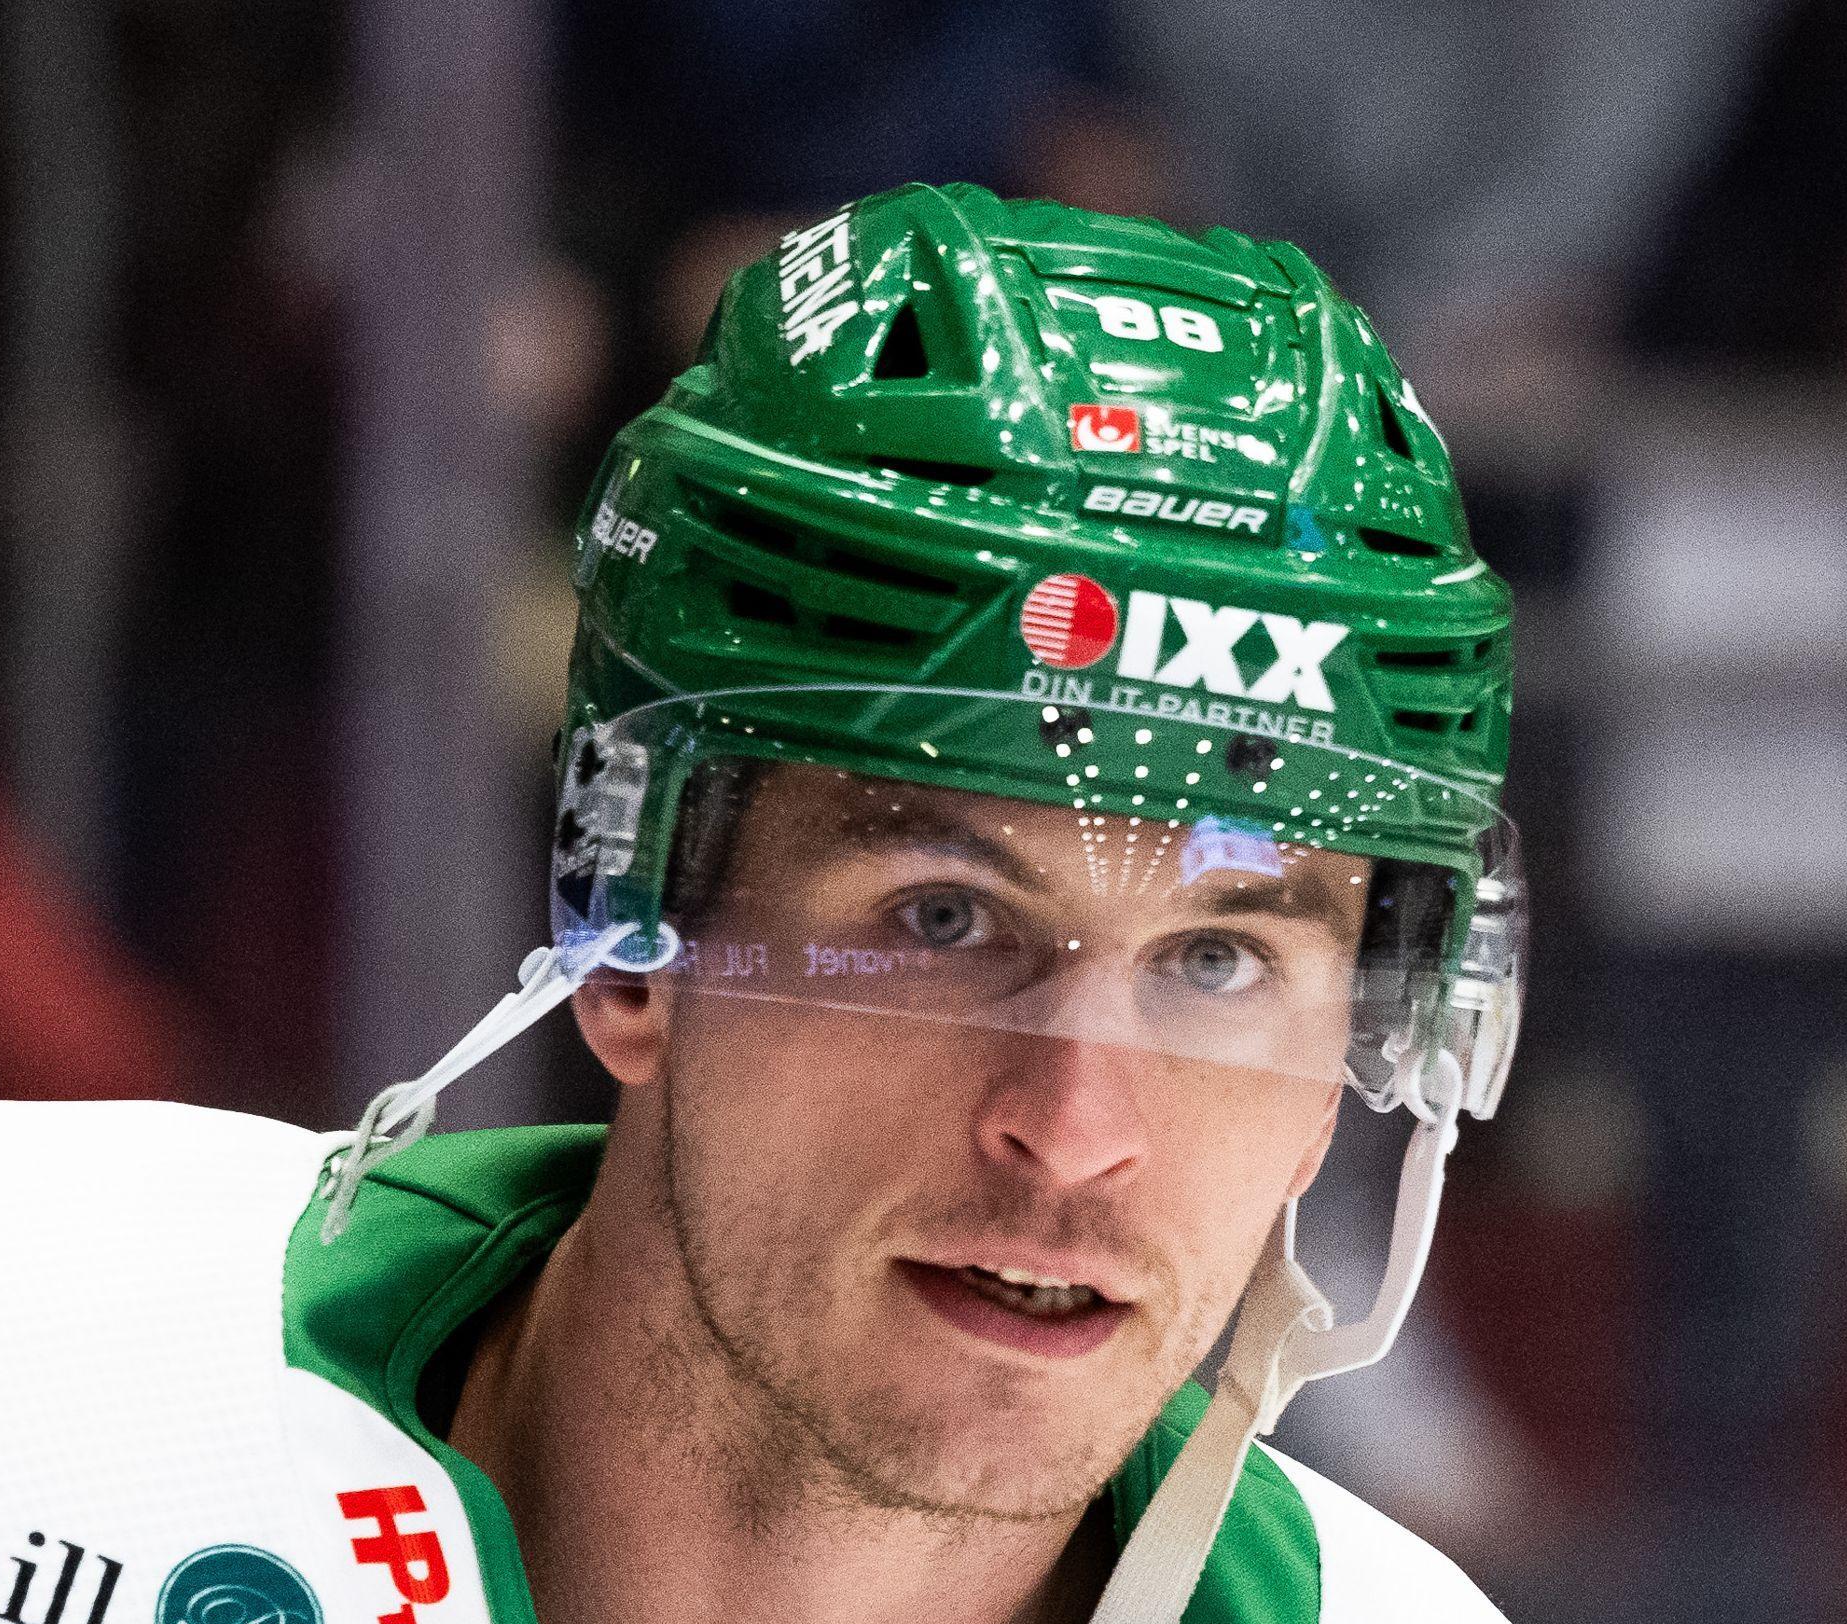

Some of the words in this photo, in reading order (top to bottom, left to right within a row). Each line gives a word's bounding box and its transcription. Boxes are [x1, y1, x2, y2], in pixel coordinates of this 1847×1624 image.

[1096, 295, 1225, 353] 88
[1082, 484, 1269, 534] BAUER
[1115, 589, 1351, 714] IXX
[1020, 668, 1094, 703] DIN
[335, 1484, 451, 1606] HP
